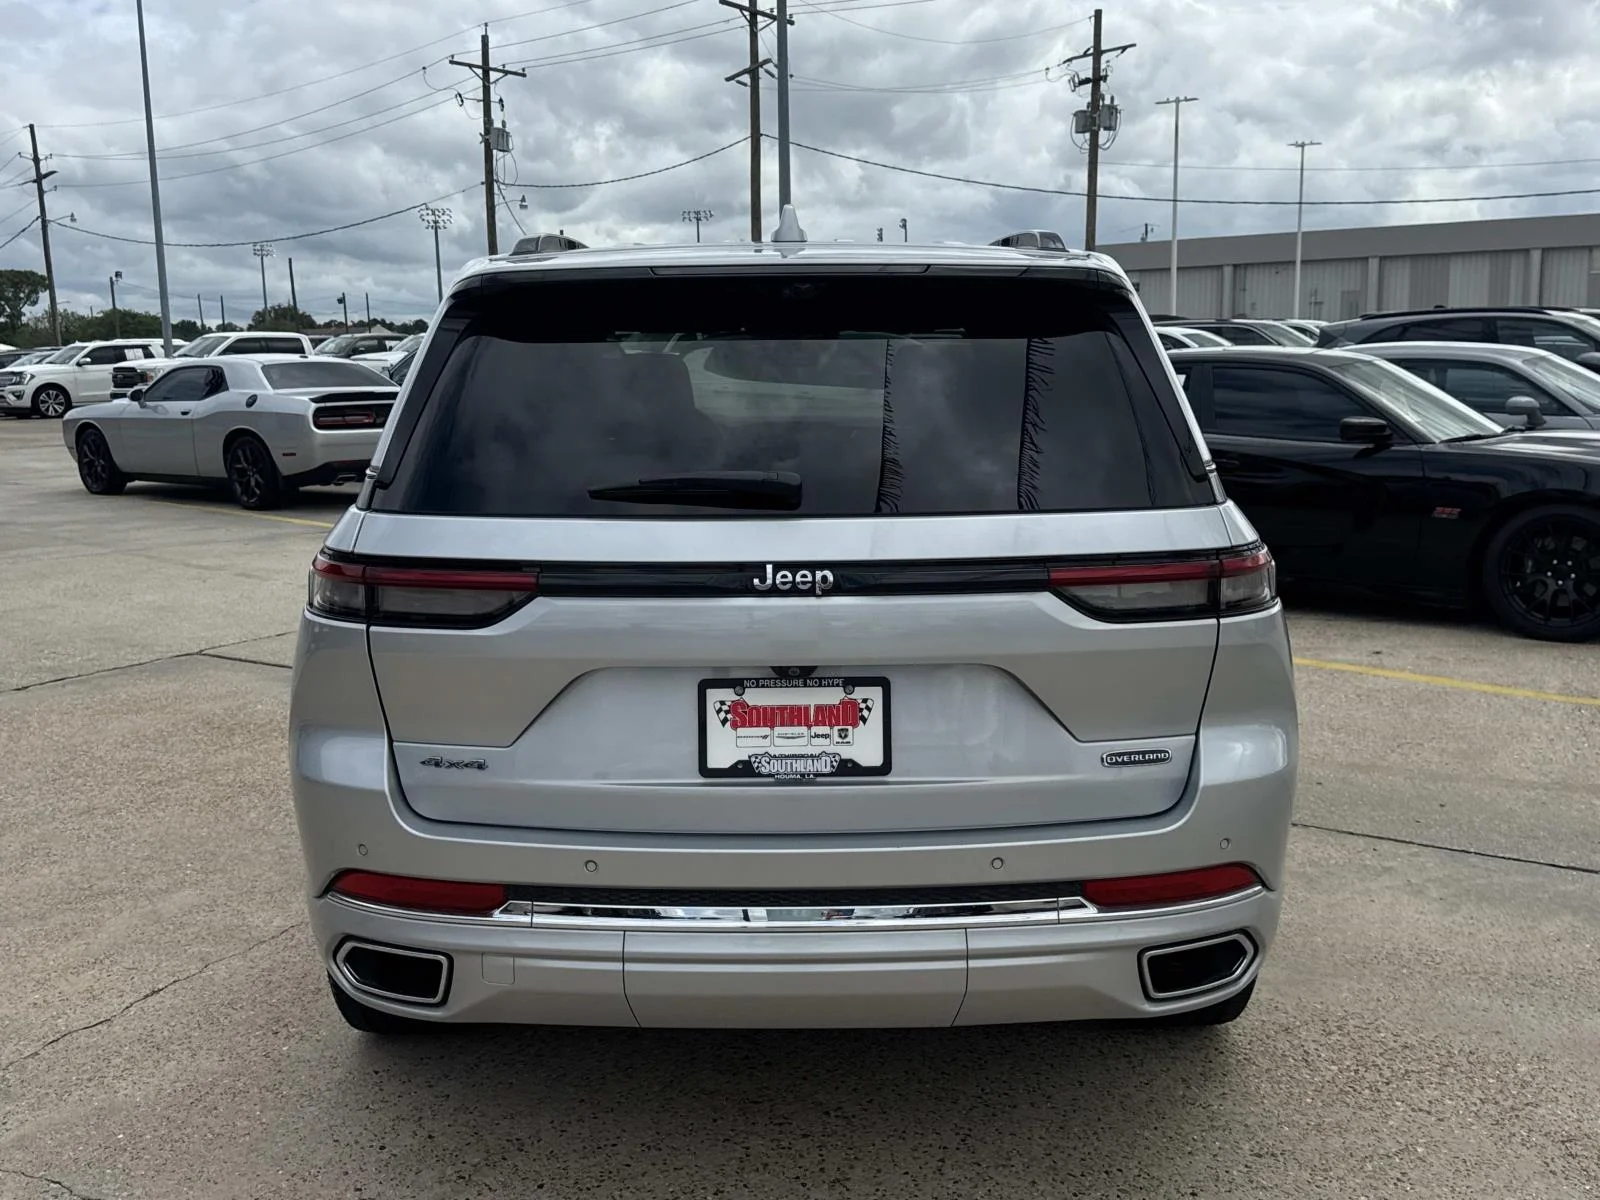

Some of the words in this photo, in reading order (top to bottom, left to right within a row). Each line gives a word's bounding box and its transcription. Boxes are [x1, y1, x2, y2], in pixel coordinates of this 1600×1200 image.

[753, 563, 834, 596] Jeep
[743, 679, 757, 688] NO
[758, 678, 805, 688] PRESSURE
[806, 678, 820, 688] NO
[821, 678, 845, 687] HYPE
[731, 700, 860, 728] SOUTHLAND
[810, 731, 831, 740] Jeep
[419, 756, 489, 771] 4x4
[760, 756, 832, 774] SOUTHLAND
[1106, 752, 1170, 763] OVERLAND
